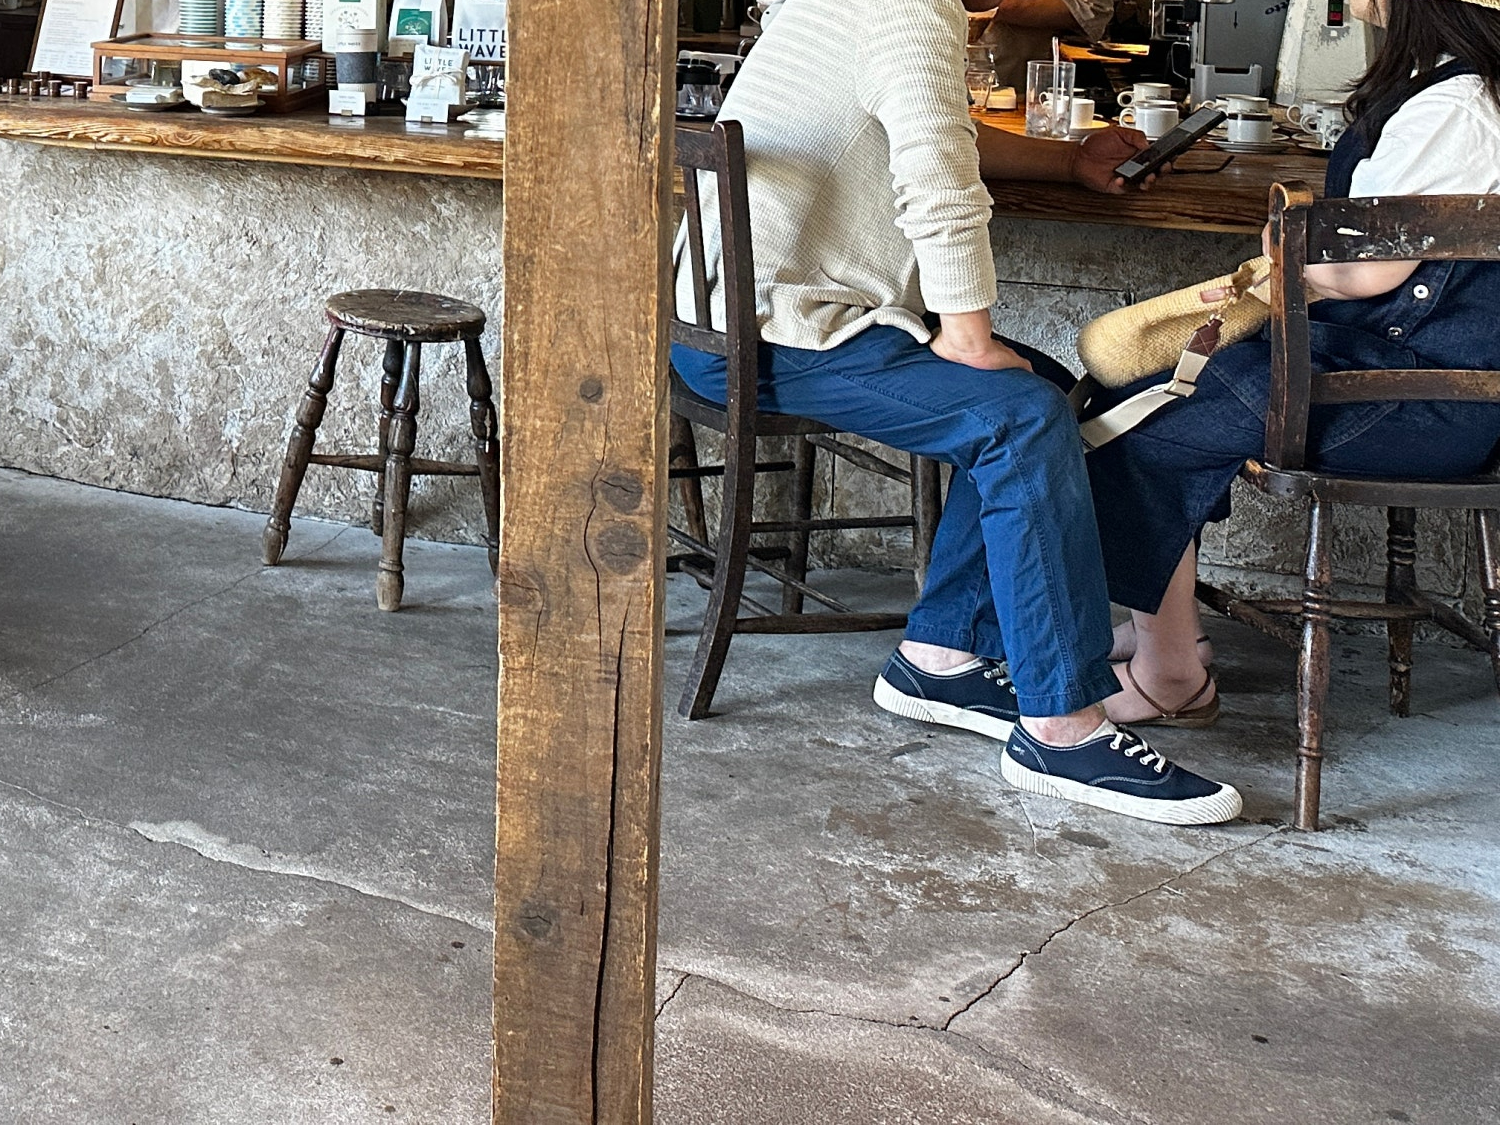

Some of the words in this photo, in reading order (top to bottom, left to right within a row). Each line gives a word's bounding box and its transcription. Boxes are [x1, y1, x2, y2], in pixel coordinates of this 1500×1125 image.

[459, 27, 506, 43] LITTL
[459, 43, 506, 58] WAVE
[424, 57, 454, 66] LITLE
